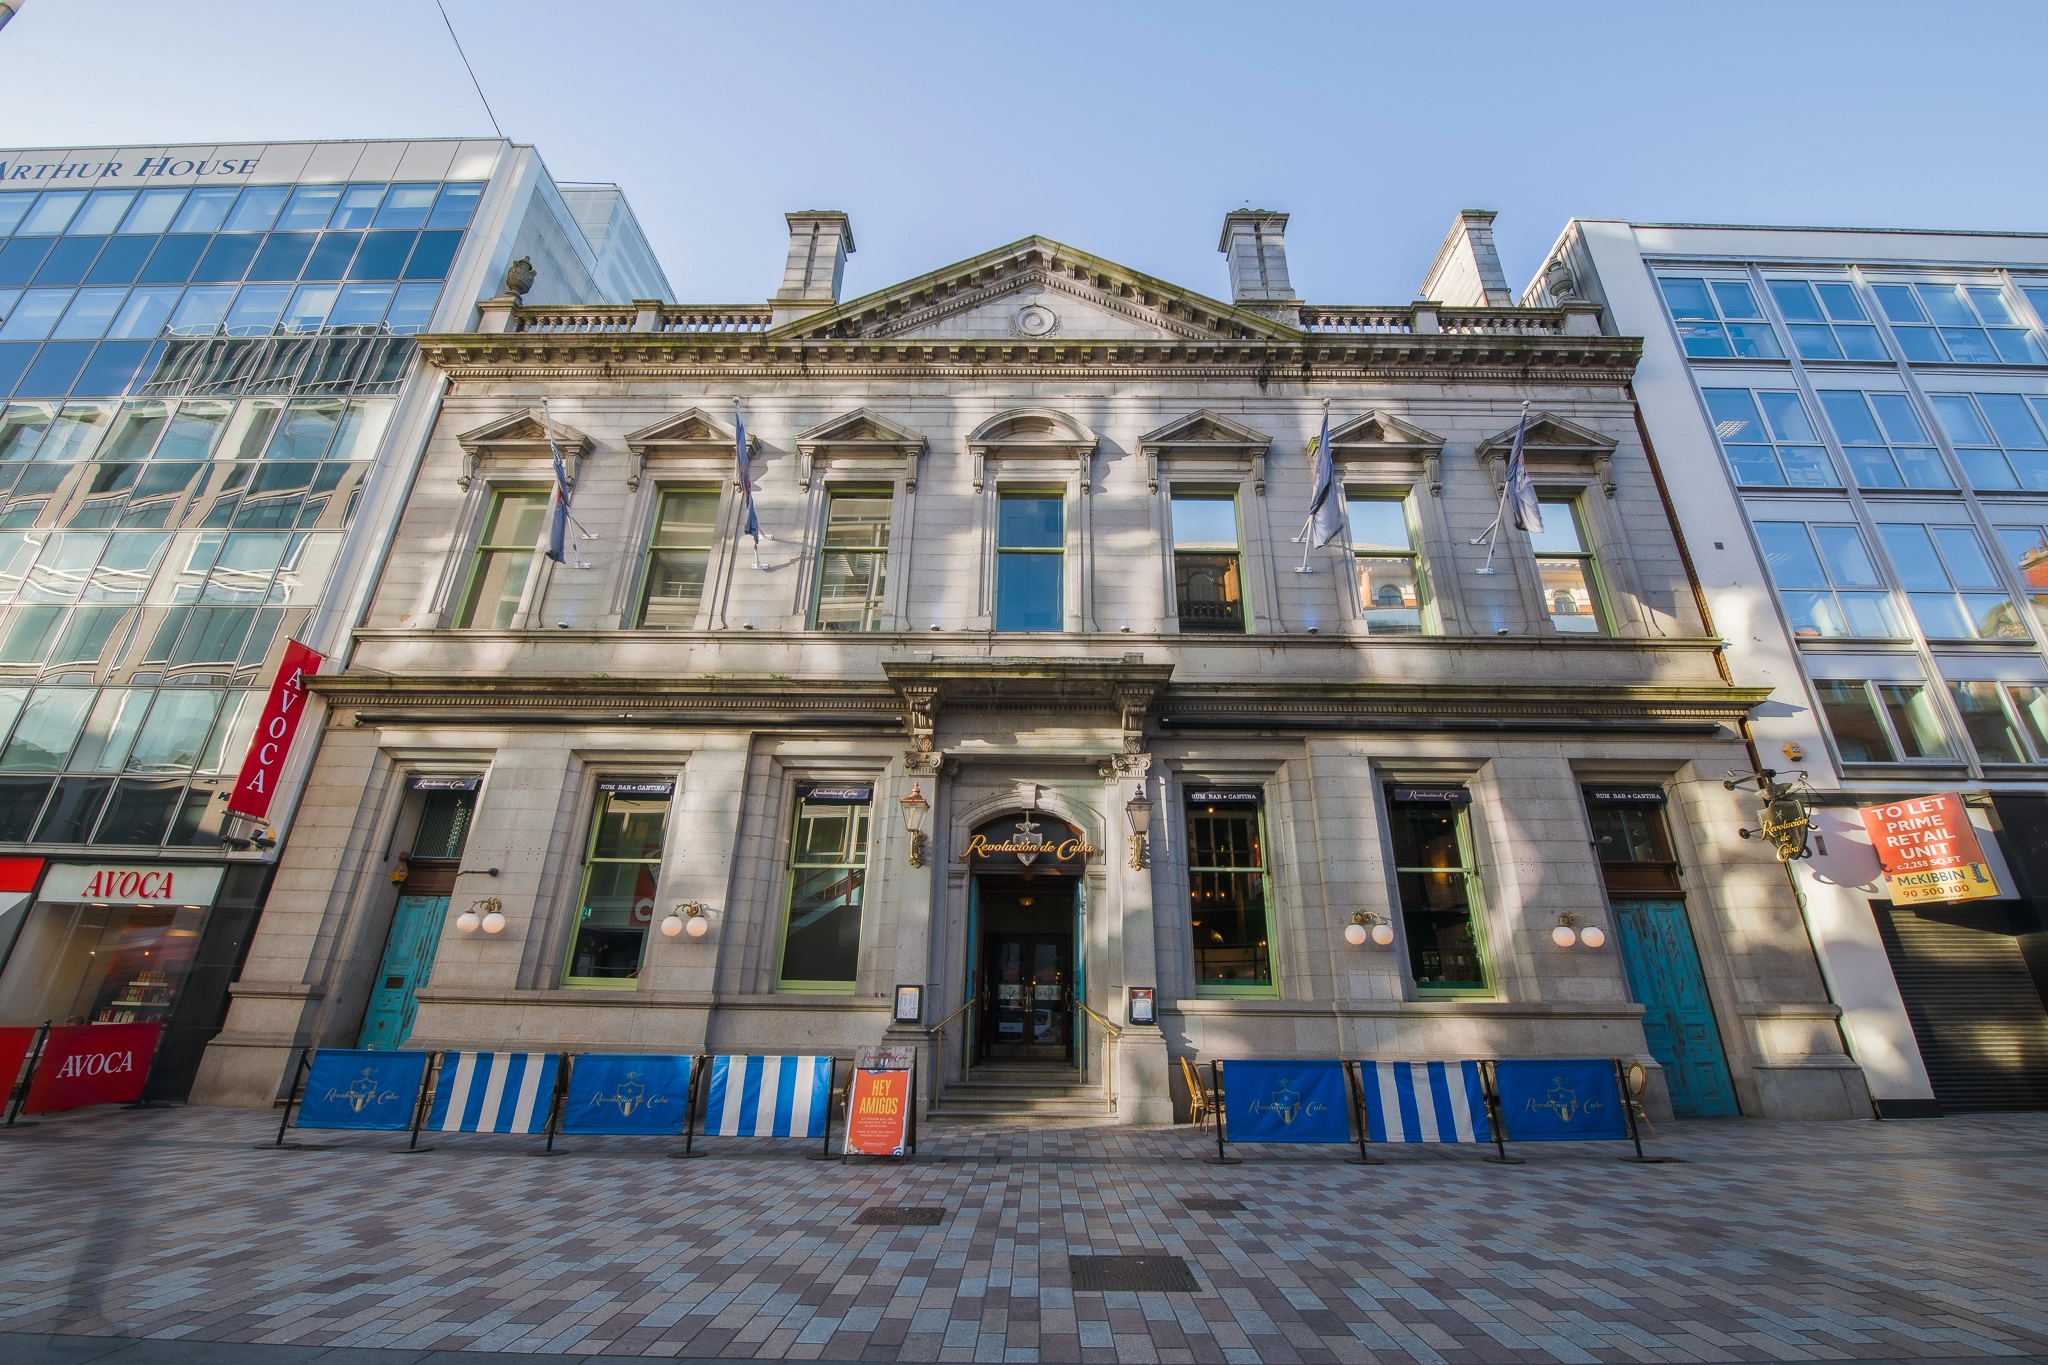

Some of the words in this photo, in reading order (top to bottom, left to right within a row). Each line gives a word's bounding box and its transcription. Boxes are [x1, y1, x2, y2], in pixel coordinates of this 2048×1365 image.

[133, 156, 260, 177] HOUSE
[246, 667, 303, 793] AVOCA
[1871, 805, 1903, 821] TO
[1907, 796, 1946, 815] LET
[1885, 814, 1944, 834] PRIME
[1886, 828, 1956, 848] RETAIL
[1776, 843, 1801, 862] Cuba
[1900, 842, 1949, 860] UNIT
[1897, 859, 1929, 870] c.2,258
[1930, 855, 1961, 867] SQ.FT
[81, 870, 174, 899] AVOCA
[1897, 869, 1966, 886] McKIBBIN
[1903, 890, 1918, 898] 90
[1922, 887, 1944, 896] 500
[1950, 884, 1970, 894] 100
[56, 1051, 133, 1079] AVOCA
[872, 1080, 892, 1096] HEY
[859, 1097, 898, 1115] AMIGOS
